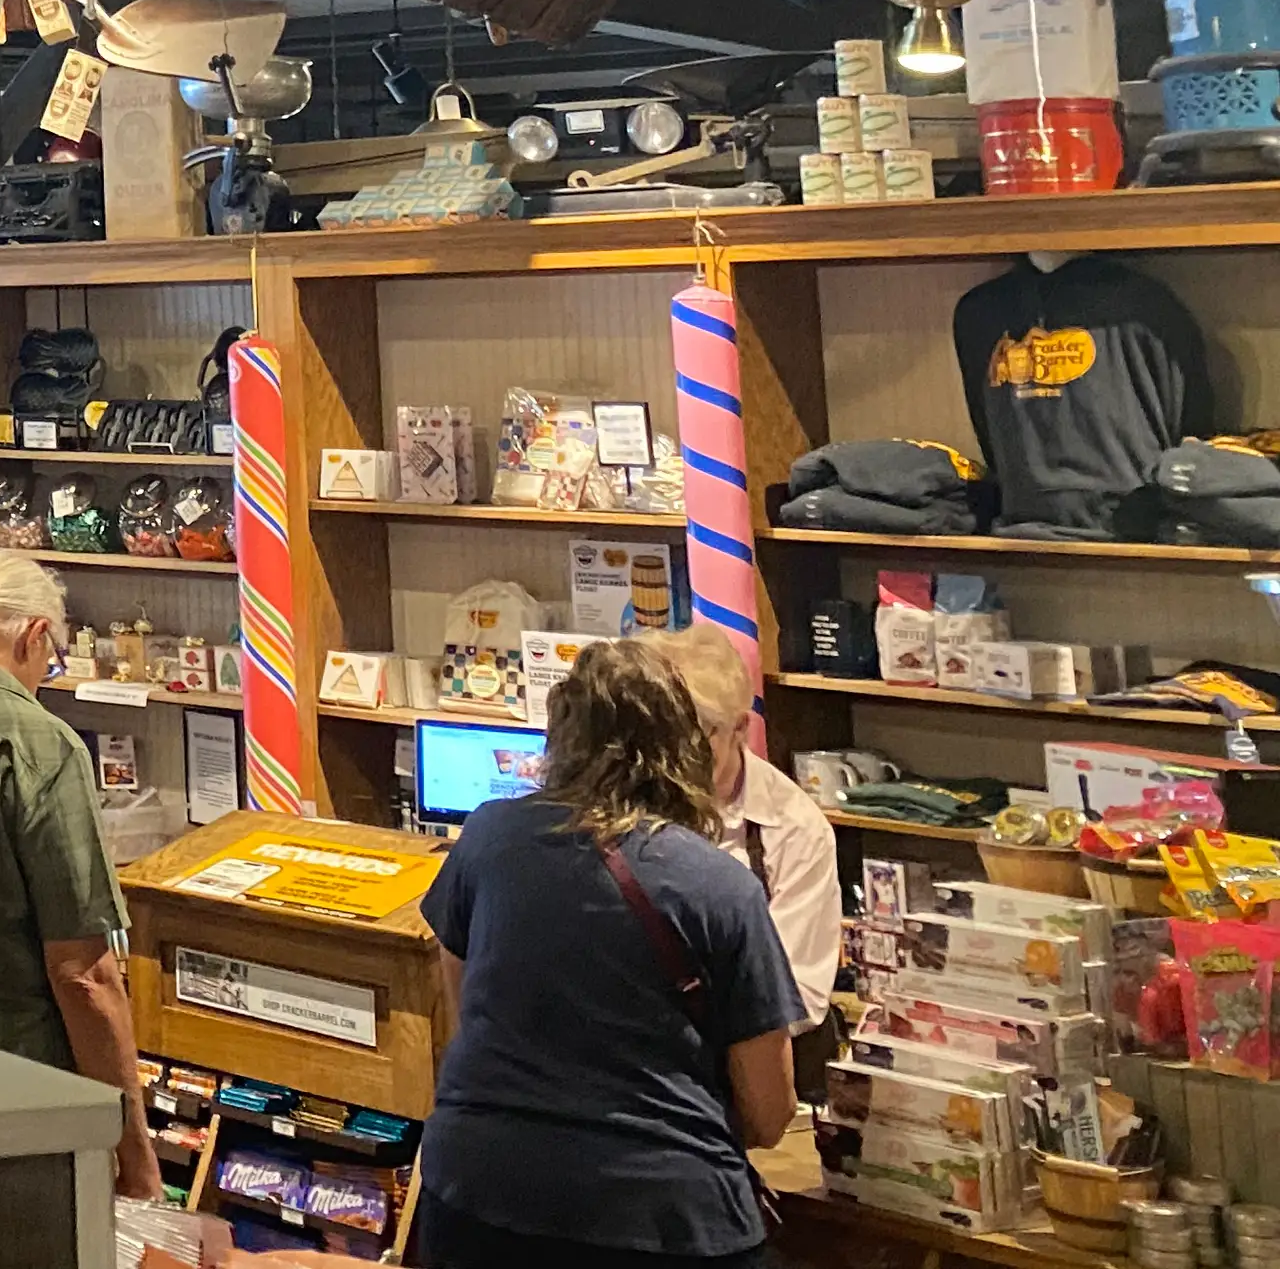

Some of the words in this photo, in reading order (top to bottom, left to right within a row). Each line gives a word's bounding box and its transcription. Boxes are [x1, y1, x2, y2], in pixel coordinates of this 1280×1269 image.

[249, 843, 404, 877] REWARDS
[262, 998, 281, 1013] SHOP
[1079, 1115, 1098, 1162] HERS
[227, 1162, 282, 1192] Milka
[307, 1185, 364, 1216] Milka
